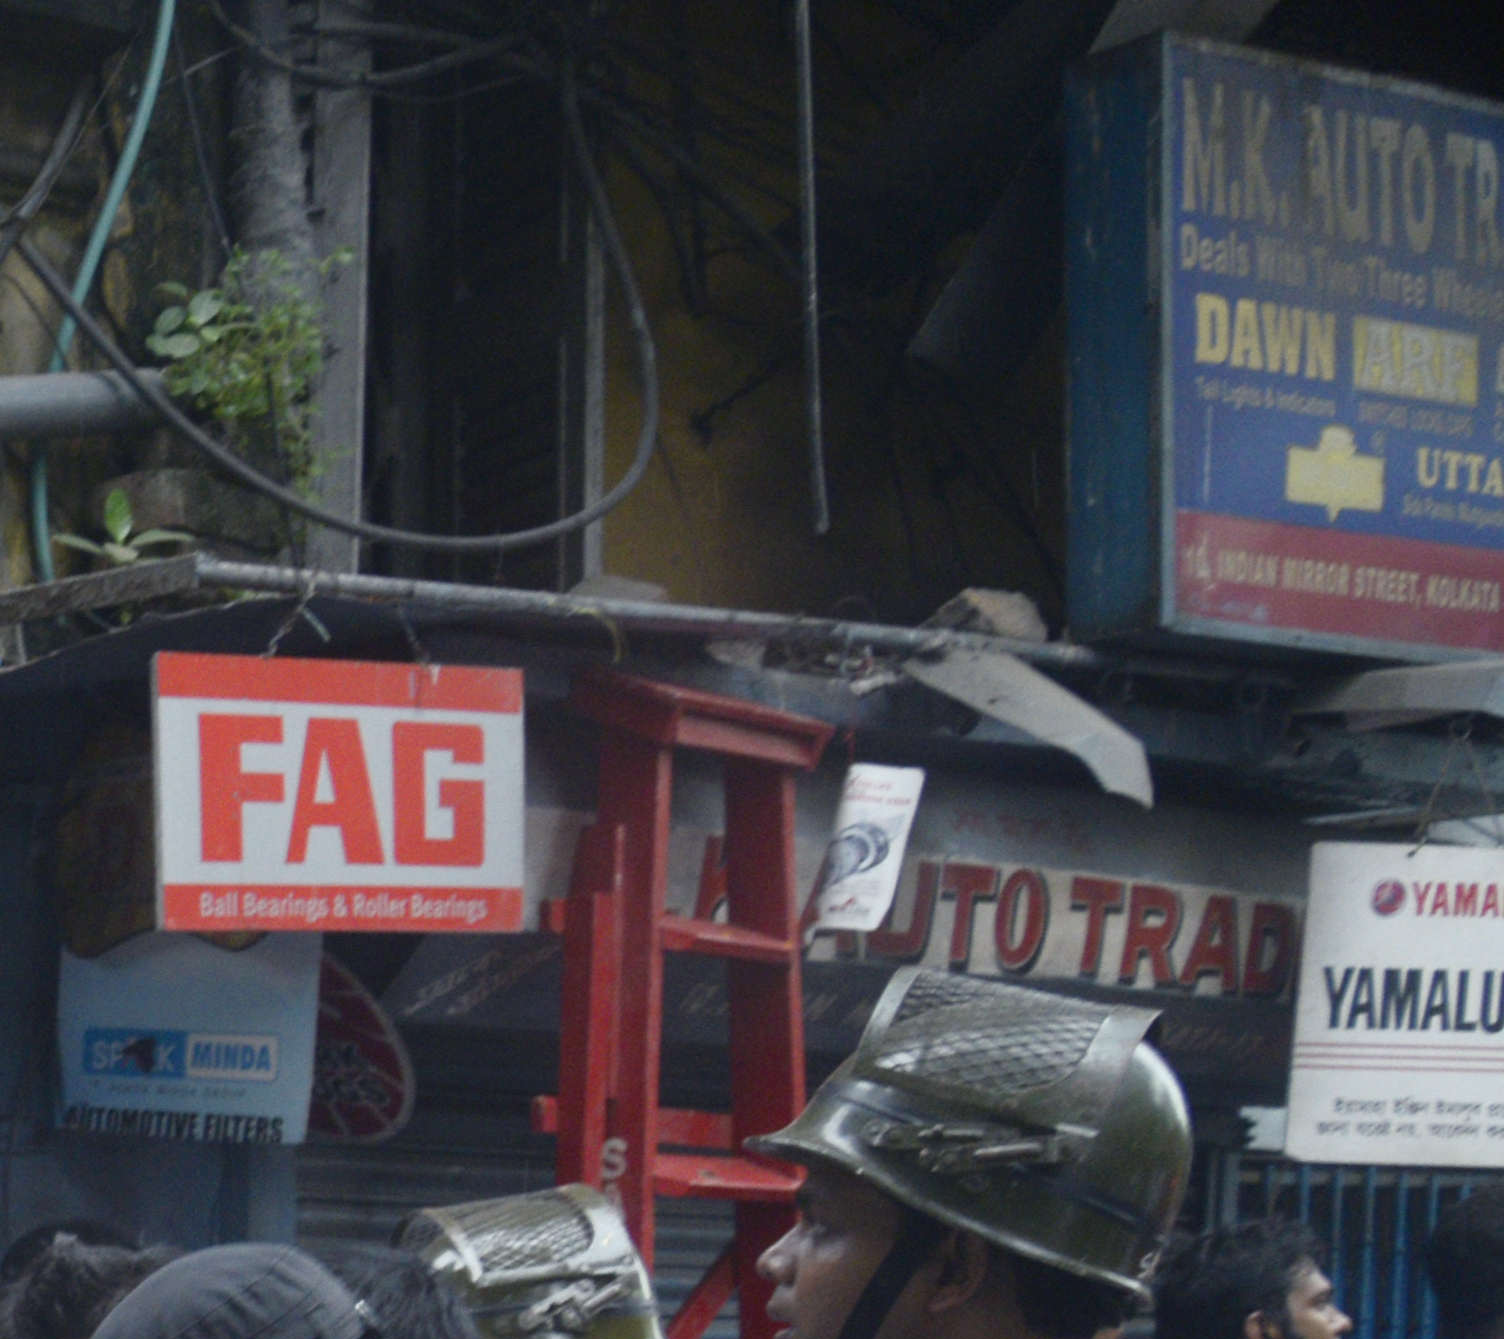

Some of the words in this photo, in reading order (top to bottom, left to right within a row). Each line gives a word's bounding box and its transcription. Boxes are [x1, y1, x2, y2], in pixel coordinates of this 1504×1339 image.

[1302, 104, 1437, 255] AUTO
[1181, 222, 1251, 278] Deals
[1194, 292, 1337, 382] DAWN
[1218, 550, 1277, 588] INDIAN
[1282, 556, 1349, 597] MIRROR
[1426, 573, 1501, 614] KOLKATA
[198, 713, 486, 869] FAG
[199, 890, 238, 918] Ball
[243, 891, 329, 923] Bearings
[333, 893, 348, 917] &
[353, 893, 406, 918] Roller
[410, 894, 487, 925] Bearings
[1412, 880, 1504, 918] YAMA
[1323, 966, 1504, 1034] YAMALU
[92, 1037, 177, 1073] SPK
[191, 1041, 272, 1071] MINDA
[202, 1112, 284, 1145] FILTERS
